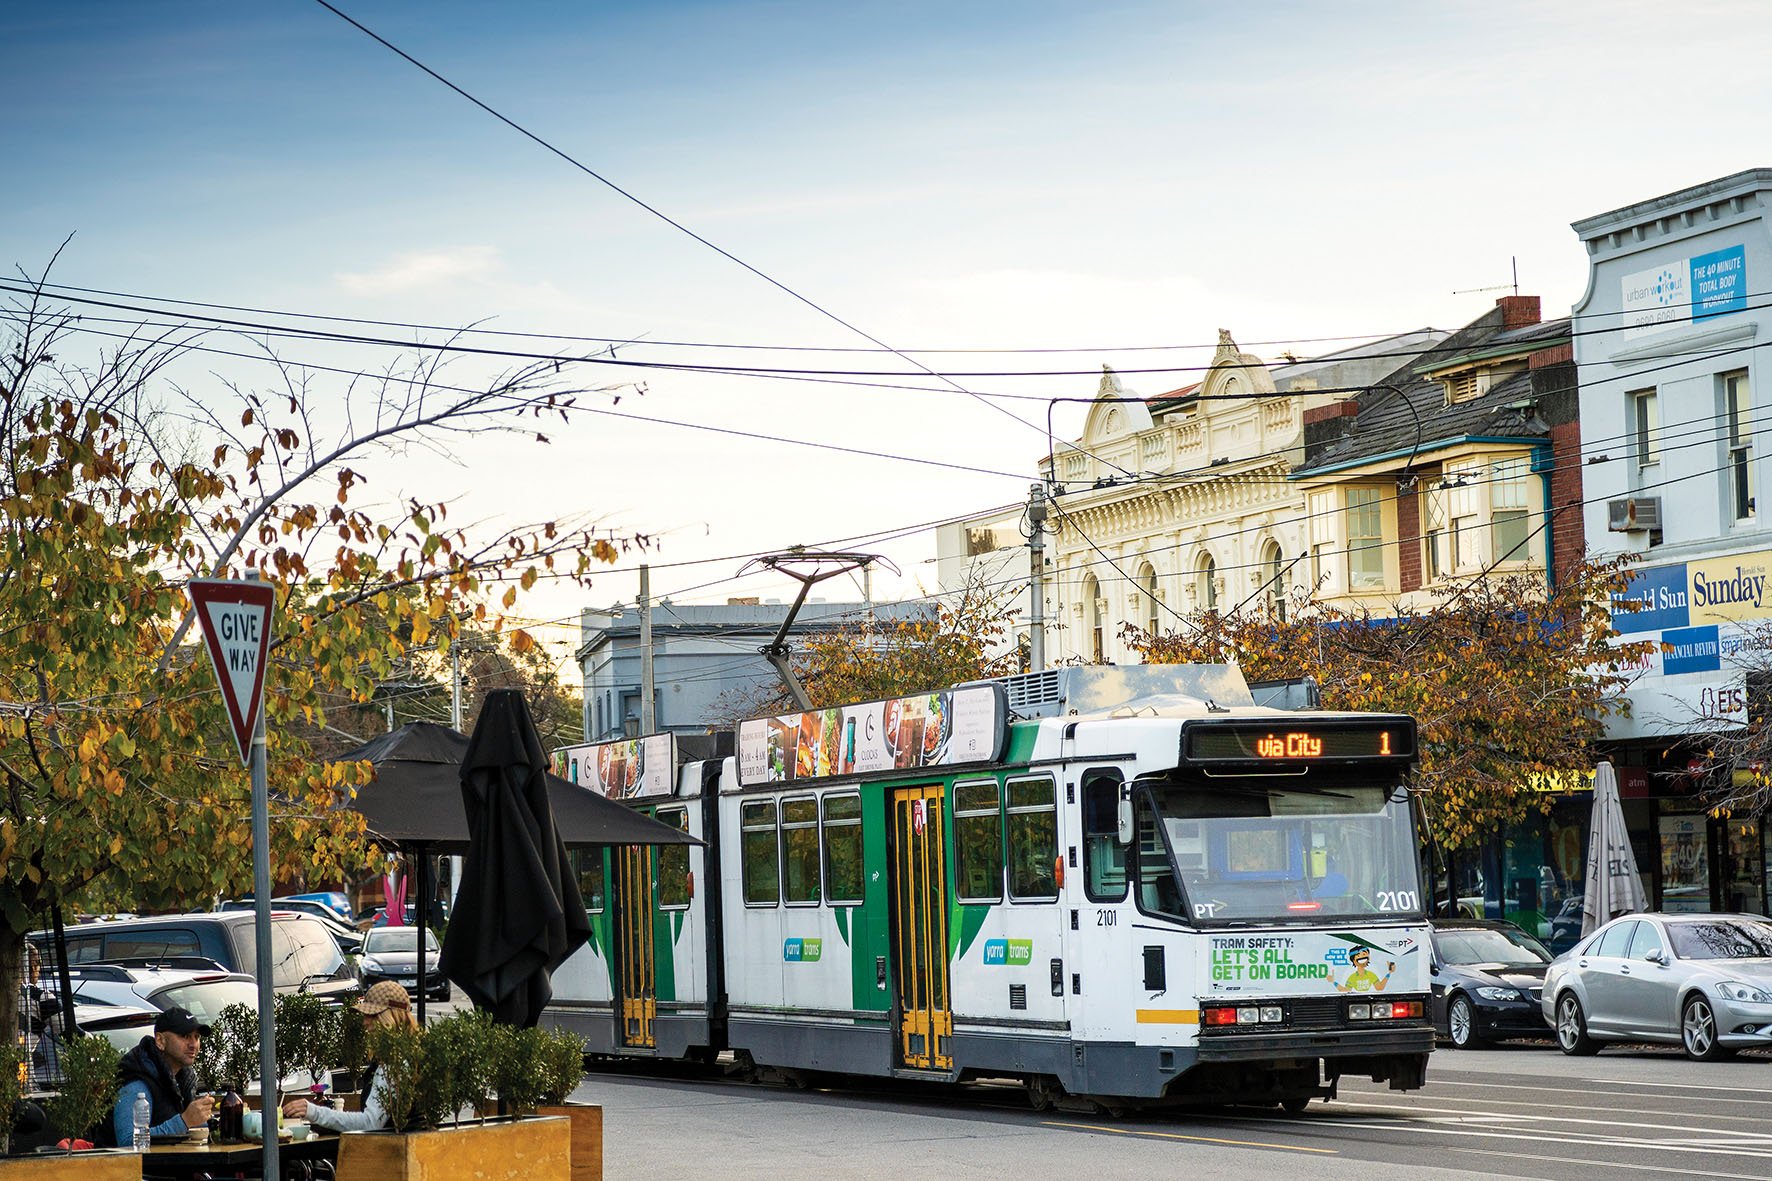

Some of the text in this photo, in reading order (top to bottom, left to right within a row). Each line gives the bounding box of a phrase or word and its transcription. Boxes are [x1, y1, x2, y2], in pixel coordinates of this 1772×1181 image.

[1694, 256, 1742, 280] THE 40 MINUTE
[1627, 278, 1682, 302] urban workout
[1699, 273, 1737, 294] TOTAL BODY
[1702, 290, 1735, 309] WORKOUT
[1693, 566, 1766, 608] Sunday
[1660, 586, 1687, 610] Sun
[221, 613, 259, 643] GIVE
[1694, 640, 1717, 657] REVIEW
[229, 648, 256, 673] WAY
[1718, 689, 1743, 713] EIS
[1257, 732, 1391, 757] via City 1
[741, 767, 755, 777] EVERY
[1628, 779, 1646, 788] atm
[1194, 902, 1214, 919] PT
[1376, 891, 1419, 912] 2101
[1097, 909, 1117, 927] 2101
[785, 942, 819, 959] yarra trams
[986, 944, 1029, 961] yarra trams
[1212, 937, 1294, 949] TRAM SAFETY:
[1212, 948, 1293, 965] LET'S ALL
[1212, 964, 1328, 980] GET ON BOARD
